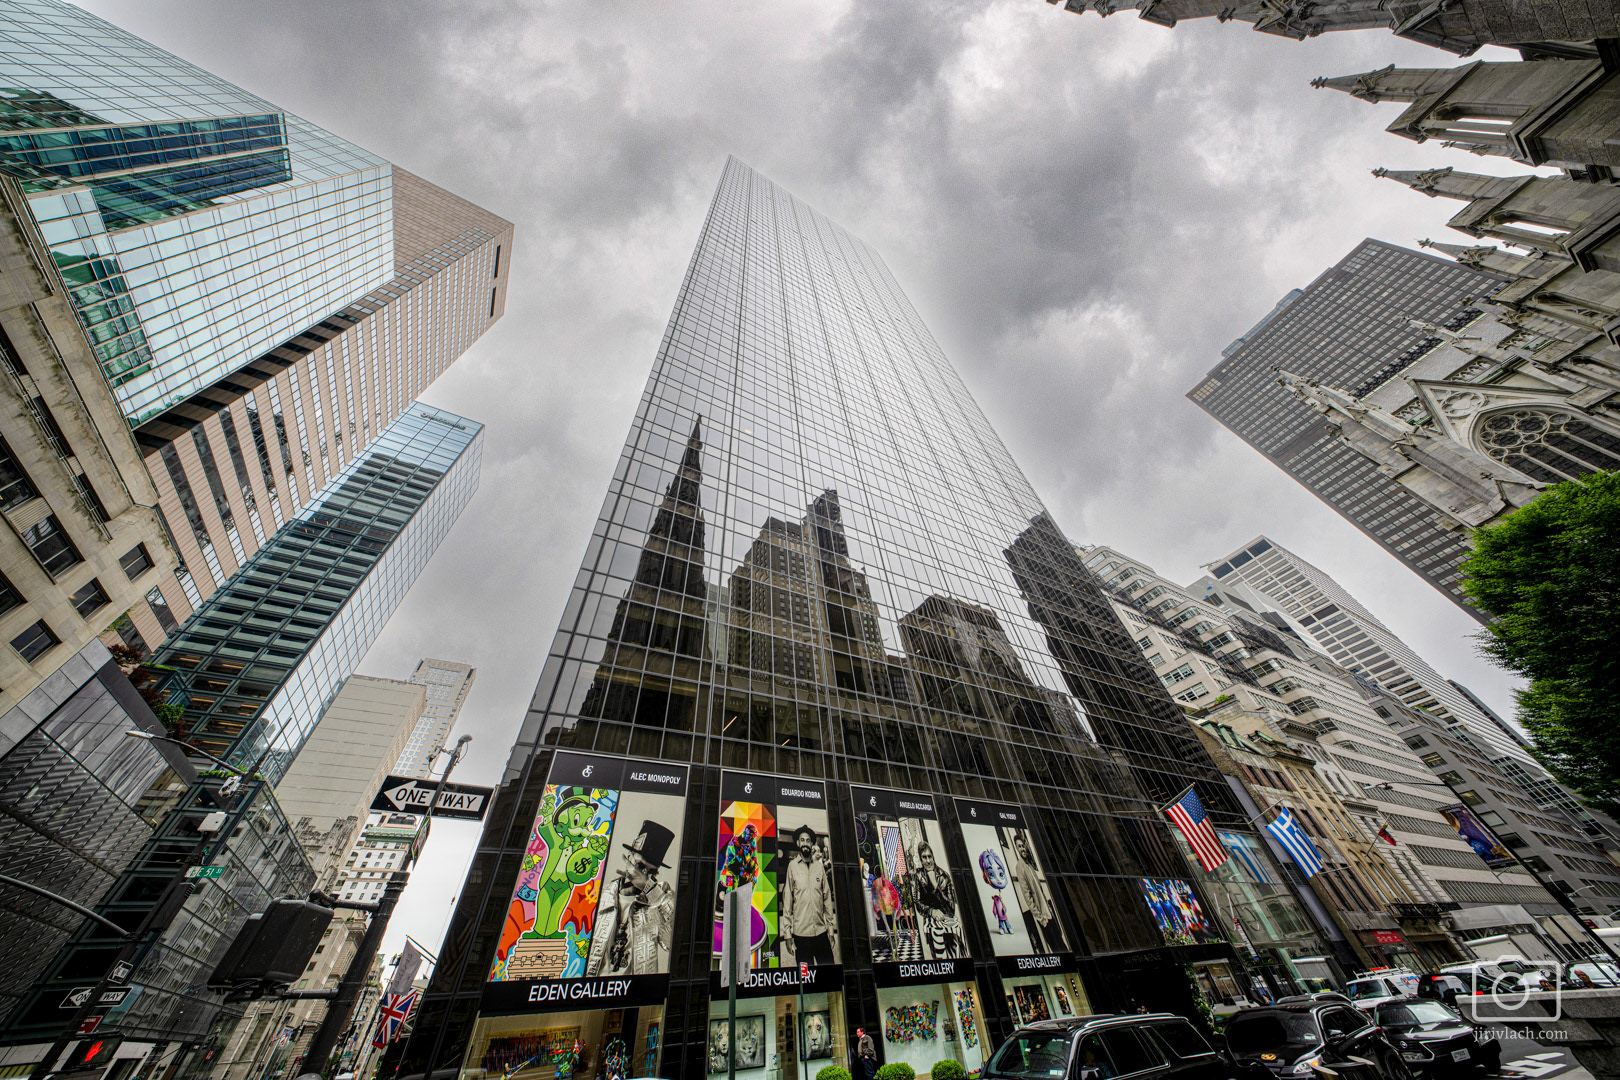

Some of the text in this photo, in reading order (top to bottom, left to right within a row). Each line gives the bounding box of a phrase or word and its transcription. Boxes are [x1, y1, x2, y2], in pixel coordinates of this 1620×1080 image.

[630, 772, 681, 785] ALEC MONOPOLY
[395, 788, 477, 809] ONE WAY
[781, 788, 821, 799] EDUARDO KOBRA
[203, 867, 215, 877] 51
[1017, 956, 1061, 969] EDEN GALLERY
[900, 962, 955, 978] EDEN GALLERY
[102, 992, 122, 1001] WAY
[528, 980, 632, 1002] EDEN GALLERY
